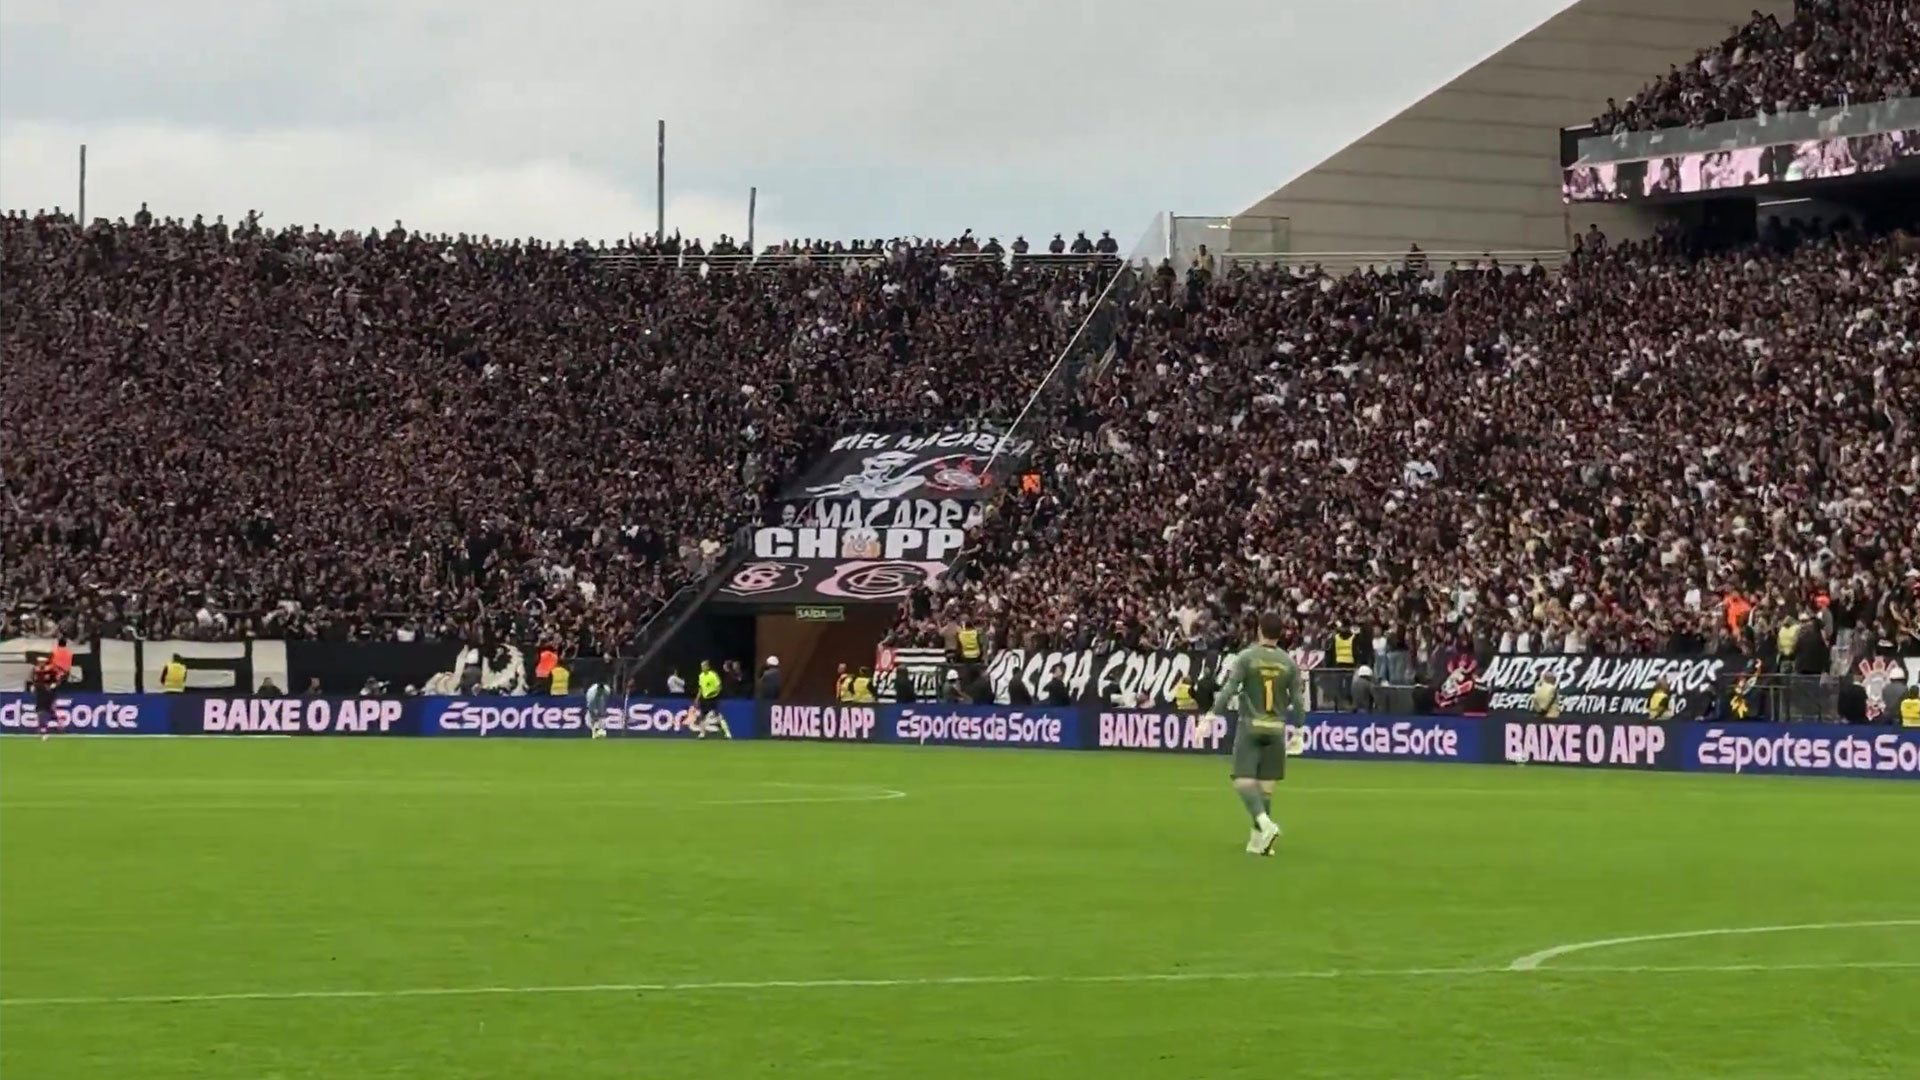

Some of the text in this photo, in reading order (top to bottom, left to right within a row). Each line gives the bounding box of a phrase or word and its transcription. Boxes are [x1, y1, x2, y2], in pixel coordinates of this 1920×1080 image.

[755, 527, 964, 558] CHPP
[1264, 680, 1273, 712] 1
[1489, 692, 1537, 711] RESPEIT
[48, 699, 139, 728] Sorte
[203, 699, 403, 731] BAIXE O APP
[771, 705, 875, 739] BAIXE O APP
[1008, 712, 1061, 743] Sorte
[1099, 713, 1161, 747] BAIXE
[1164, 714, 1179, 748] O
[1361, 723, 1390, 753] da
[1392, 722, 1458, 755] Sorte
[1505, 723, 1665, 764] BAIXE O APP
[1834, 735, 1872, 769] da
[1875, 734, 1920, 773] So
